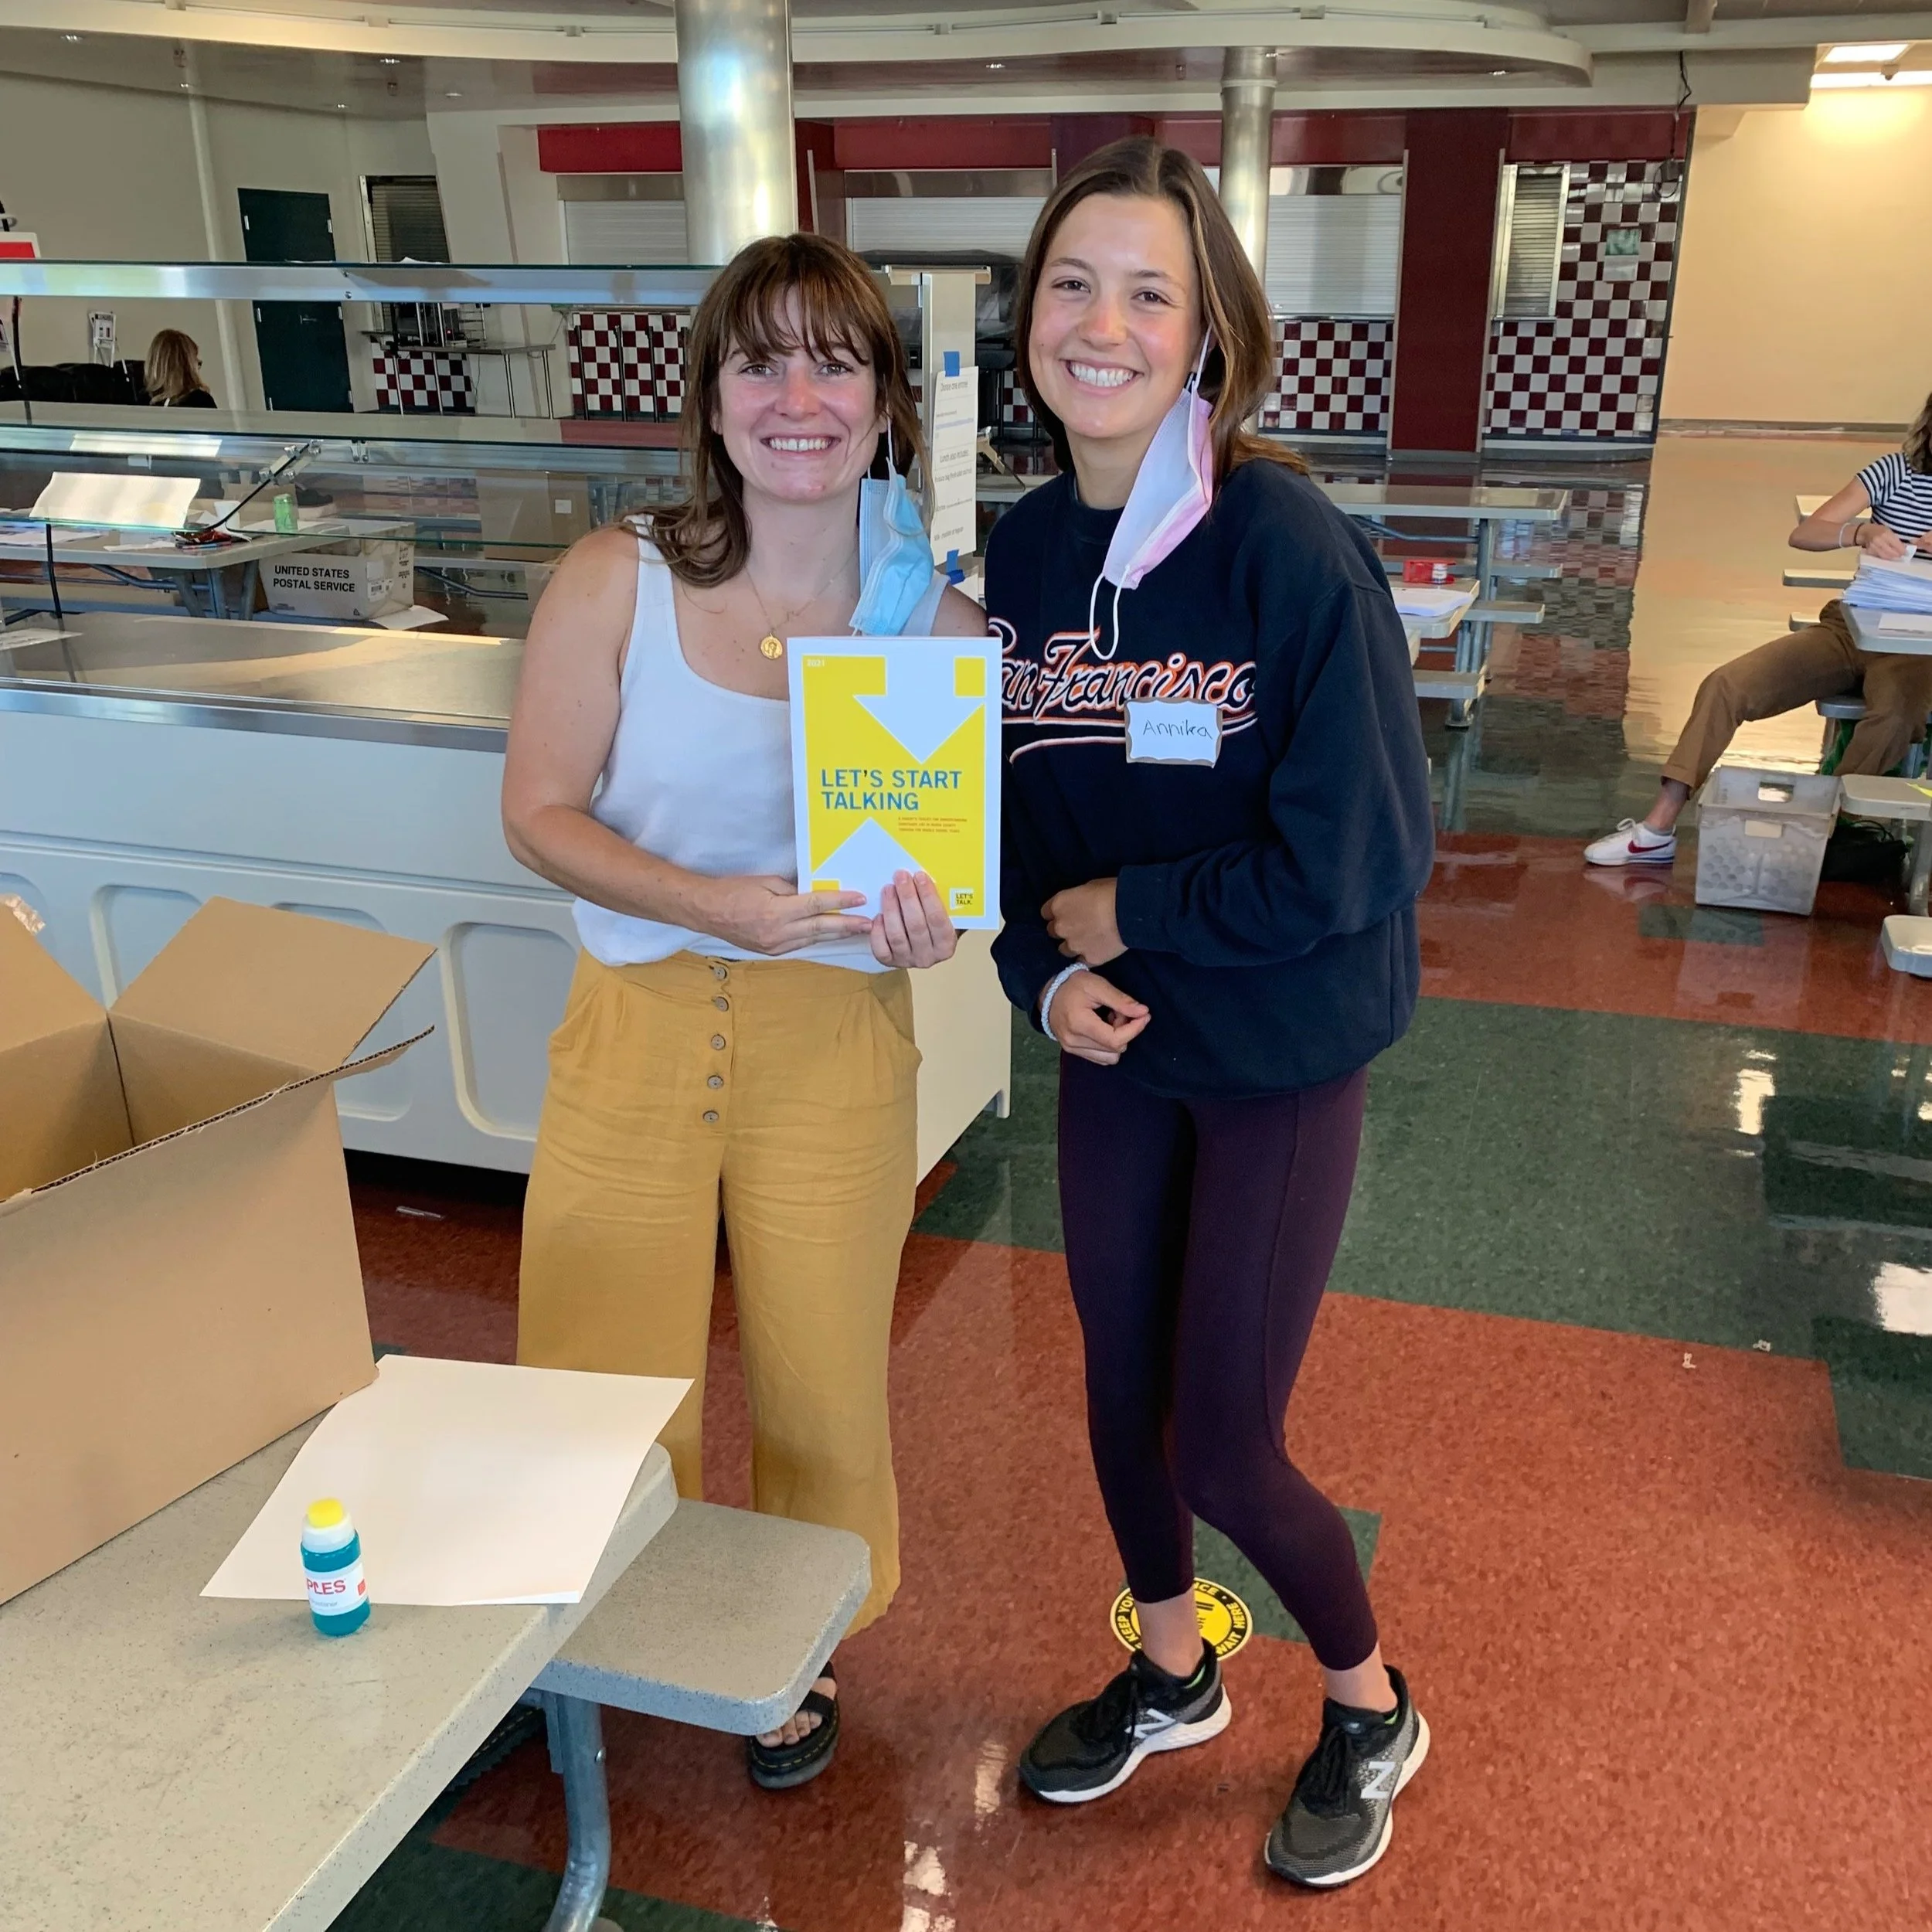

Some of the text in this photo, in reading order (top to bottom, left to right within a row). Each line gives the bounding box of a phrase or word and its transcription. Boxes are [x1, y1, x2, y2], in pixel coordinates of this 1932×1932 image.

[274, 565, 349, 579] UNITED STATES
[273, 578, 355, 592] POSTAL SERVICE
[1033, 624, 1257, 722] Francisco
[1143, 719, 1213, 740] Annika
[821, 768, 962, 789] LET'S START
[821, 791, 920, 811] TALKING
[1117, 1614, 1139, 1642] KEEP
[1216, 1601, 1246, 1655] WAIT HERE
